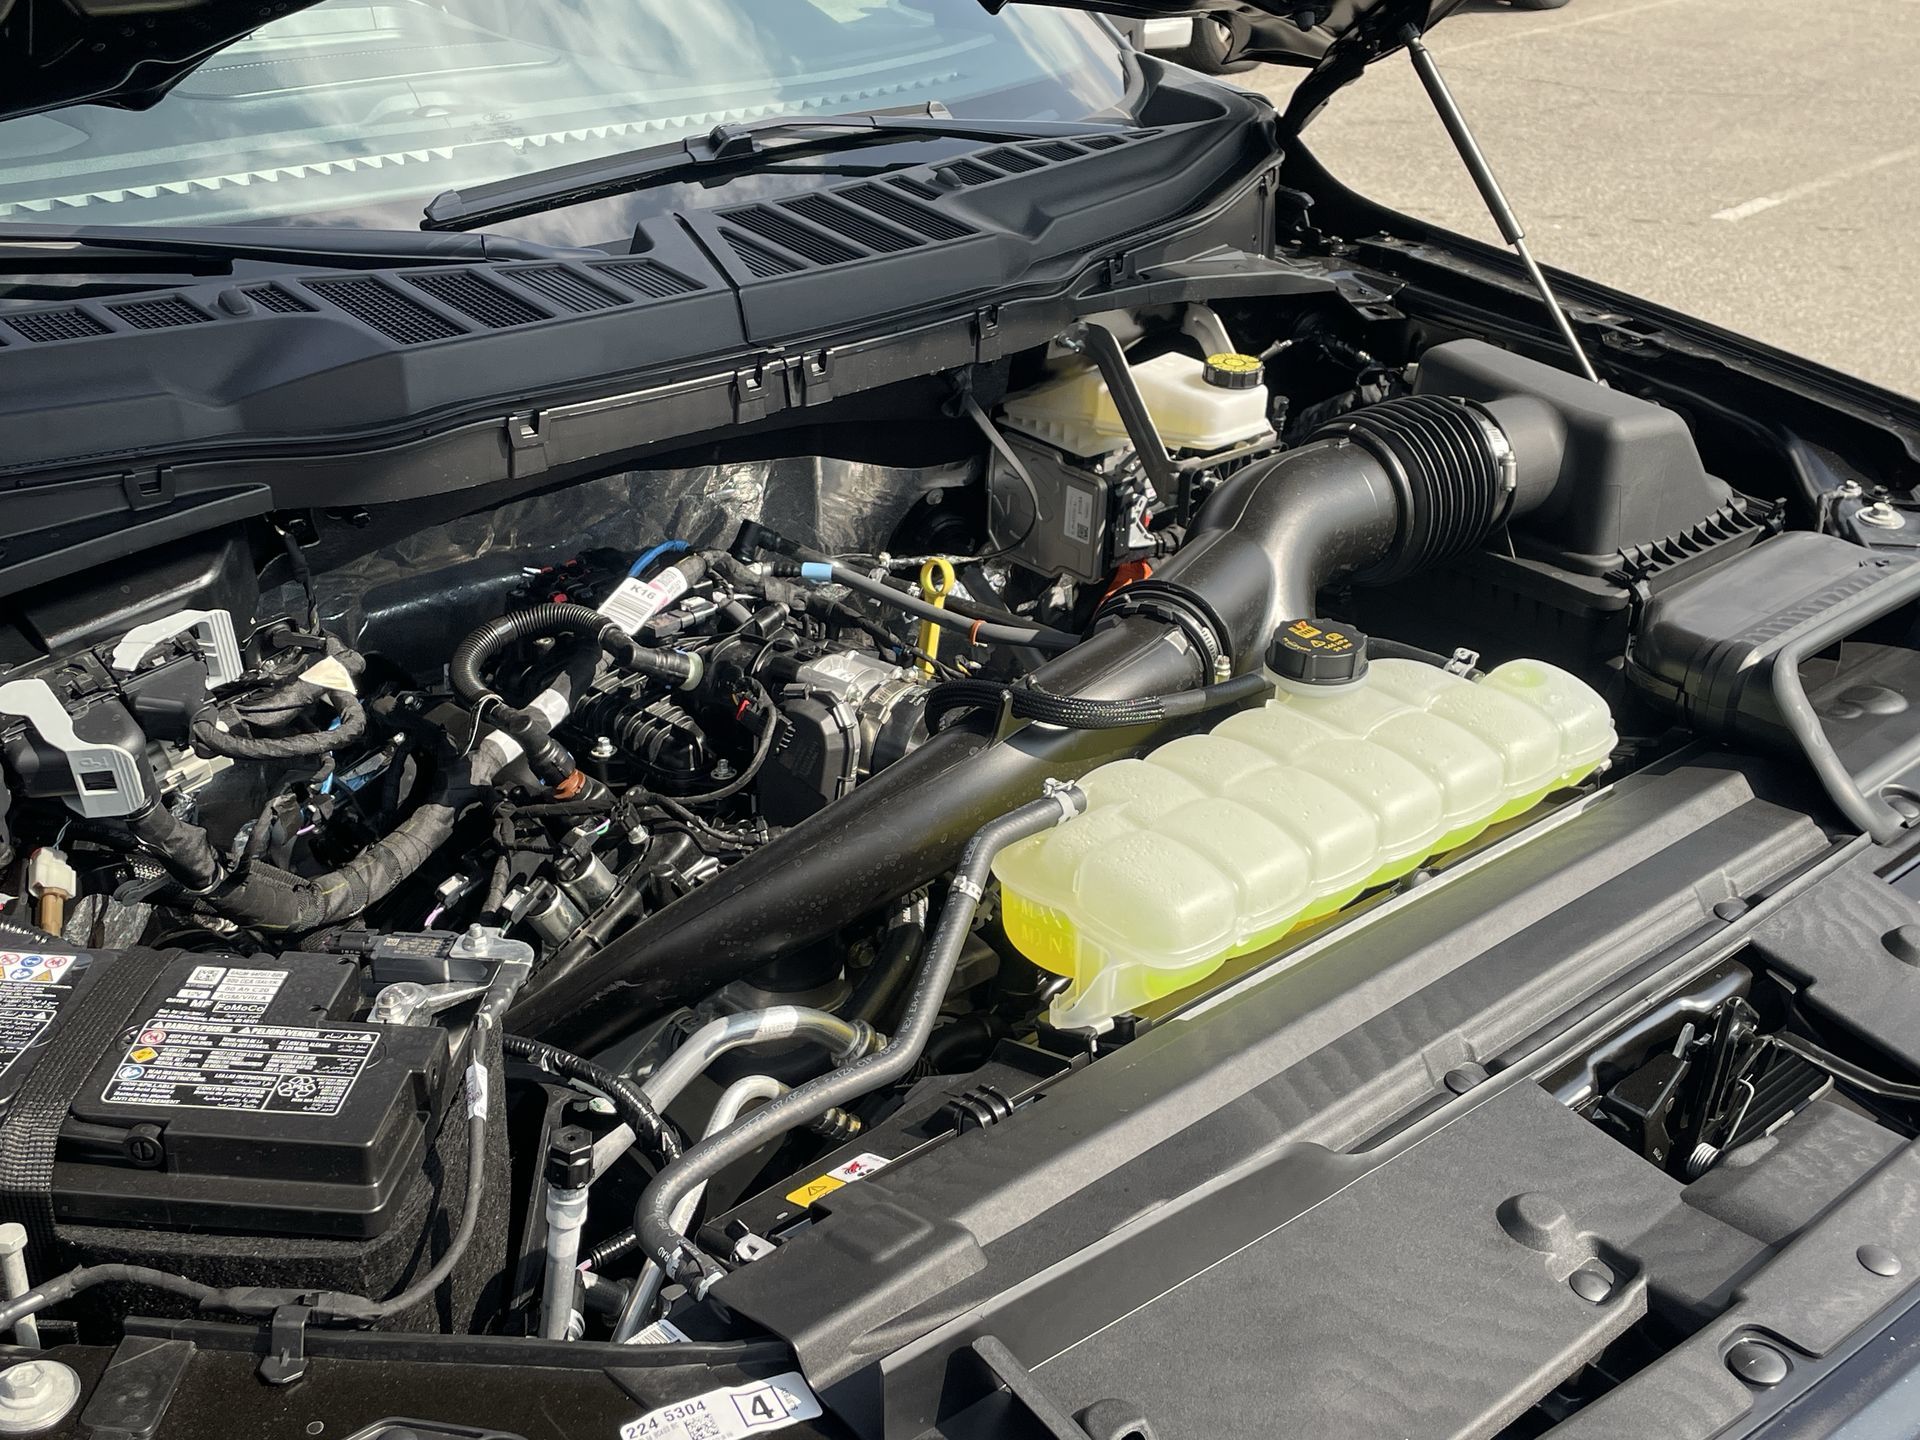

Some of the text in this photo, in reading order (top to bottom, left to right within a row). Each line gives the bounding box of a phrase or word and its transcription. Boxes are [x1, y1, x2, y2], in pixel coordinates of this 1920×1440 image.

[630, 584, 657, 599] K16
[189, 1000, 214, 1008] MF
[216, 1003, 264, 1012] FoMoCo
[163, 1022, 320, 1038] DANGER/POISON PELIGRO/VENENO
[657, 1246, 672, 1262] RAD
[751, 1395, 774, 1419] 4
[626, 1400, 706, 1440] 224 5304
